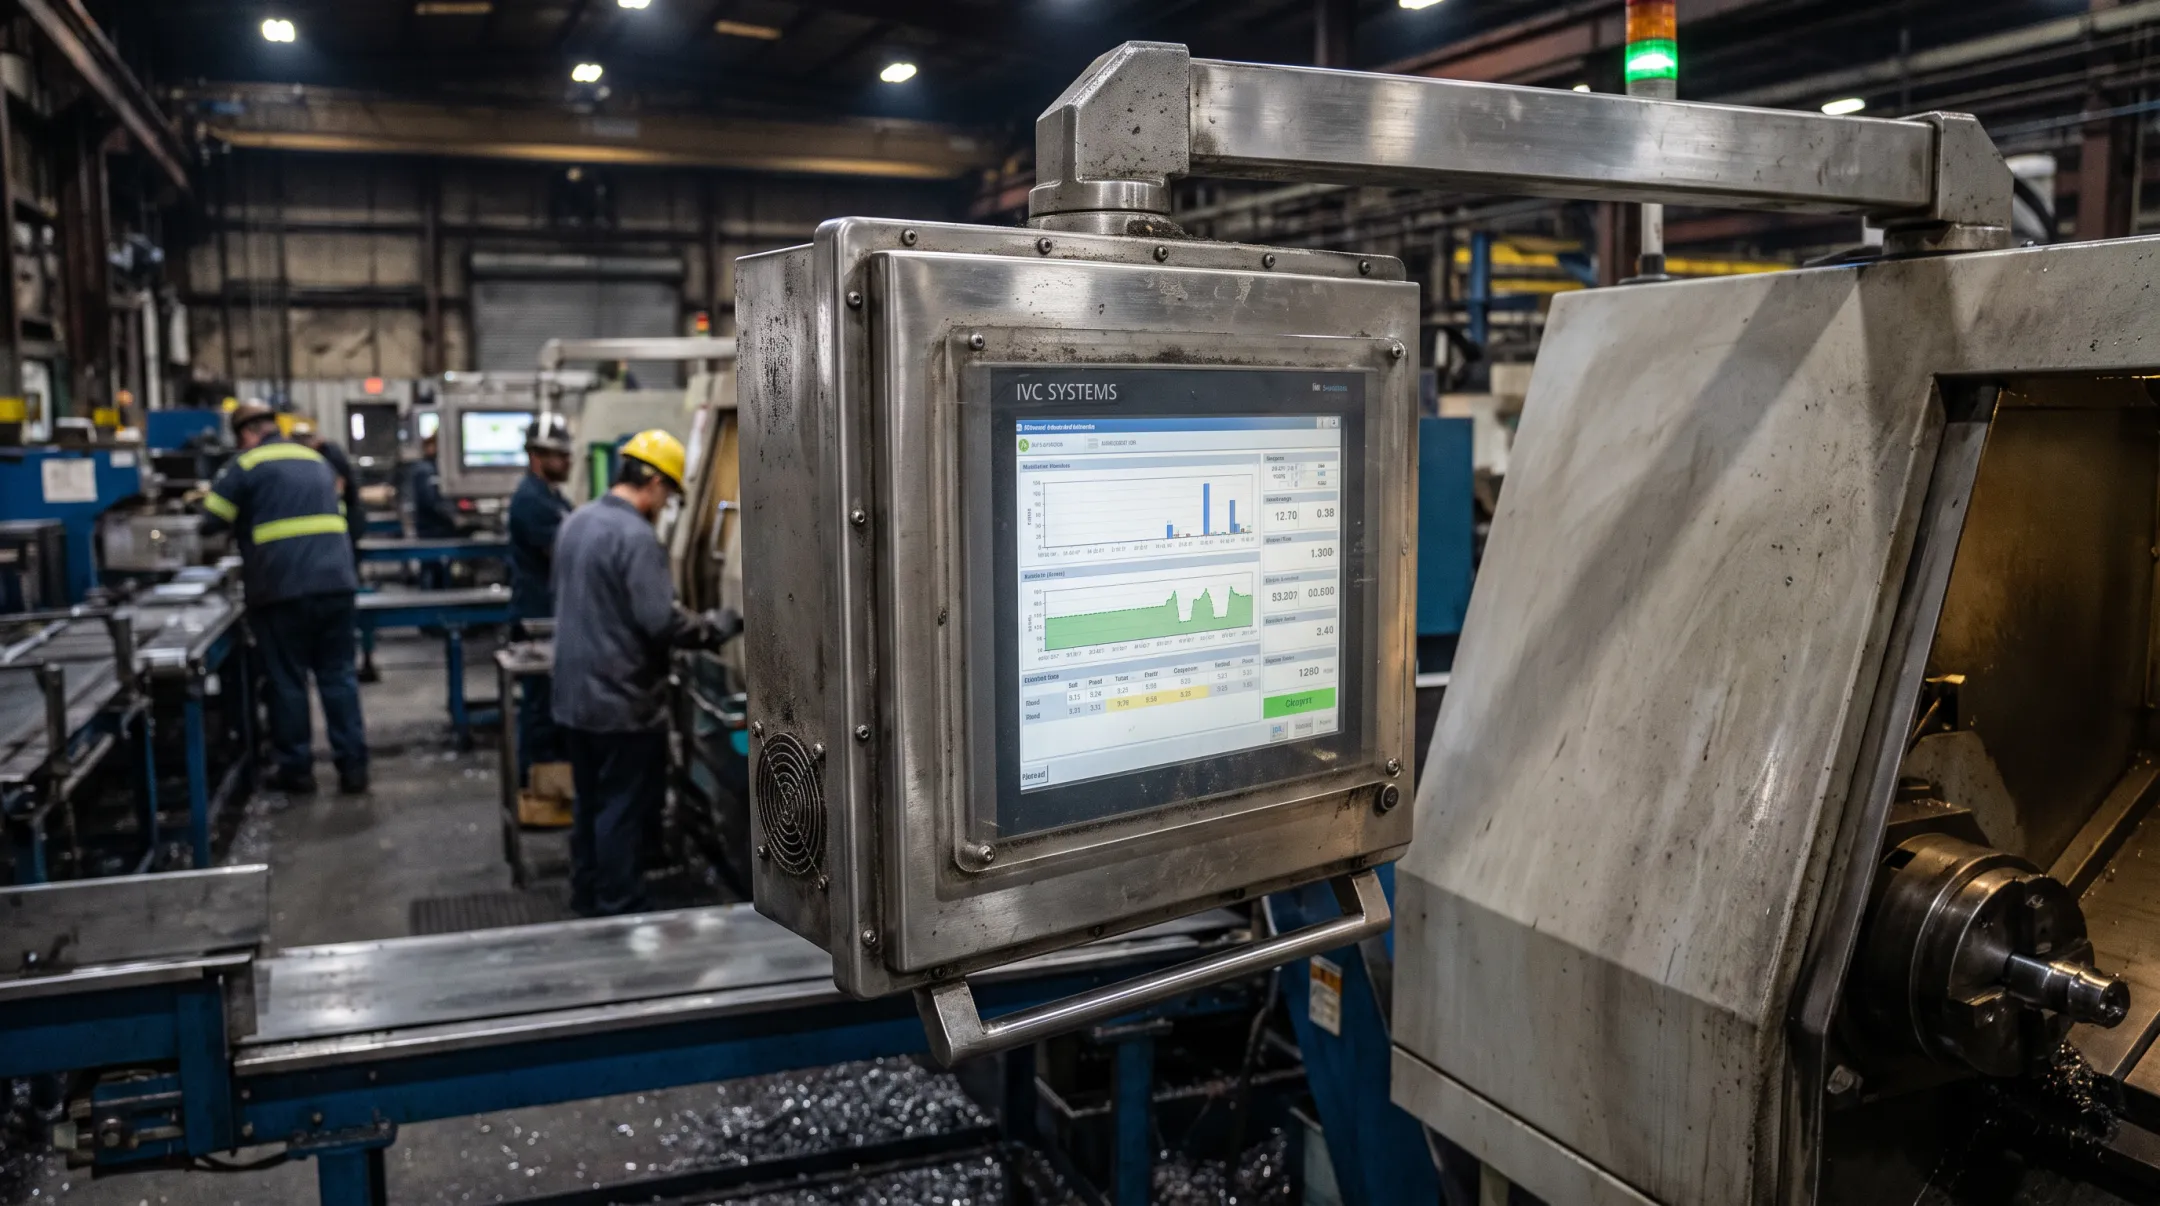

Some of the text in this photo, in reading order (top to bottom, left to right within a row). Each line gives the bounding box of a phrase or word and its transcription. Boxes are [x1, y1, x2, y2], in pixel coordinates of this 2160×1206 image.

[1017, 383, 1117, 401] IVC SYSTEMS
[1275, 510, 1298, 521] 12.70
[1316, 508, 1335, 518] 0.38
[1316, 626, 1334, 636] 3.40
[1299, 666, 1320, 678] 1280
